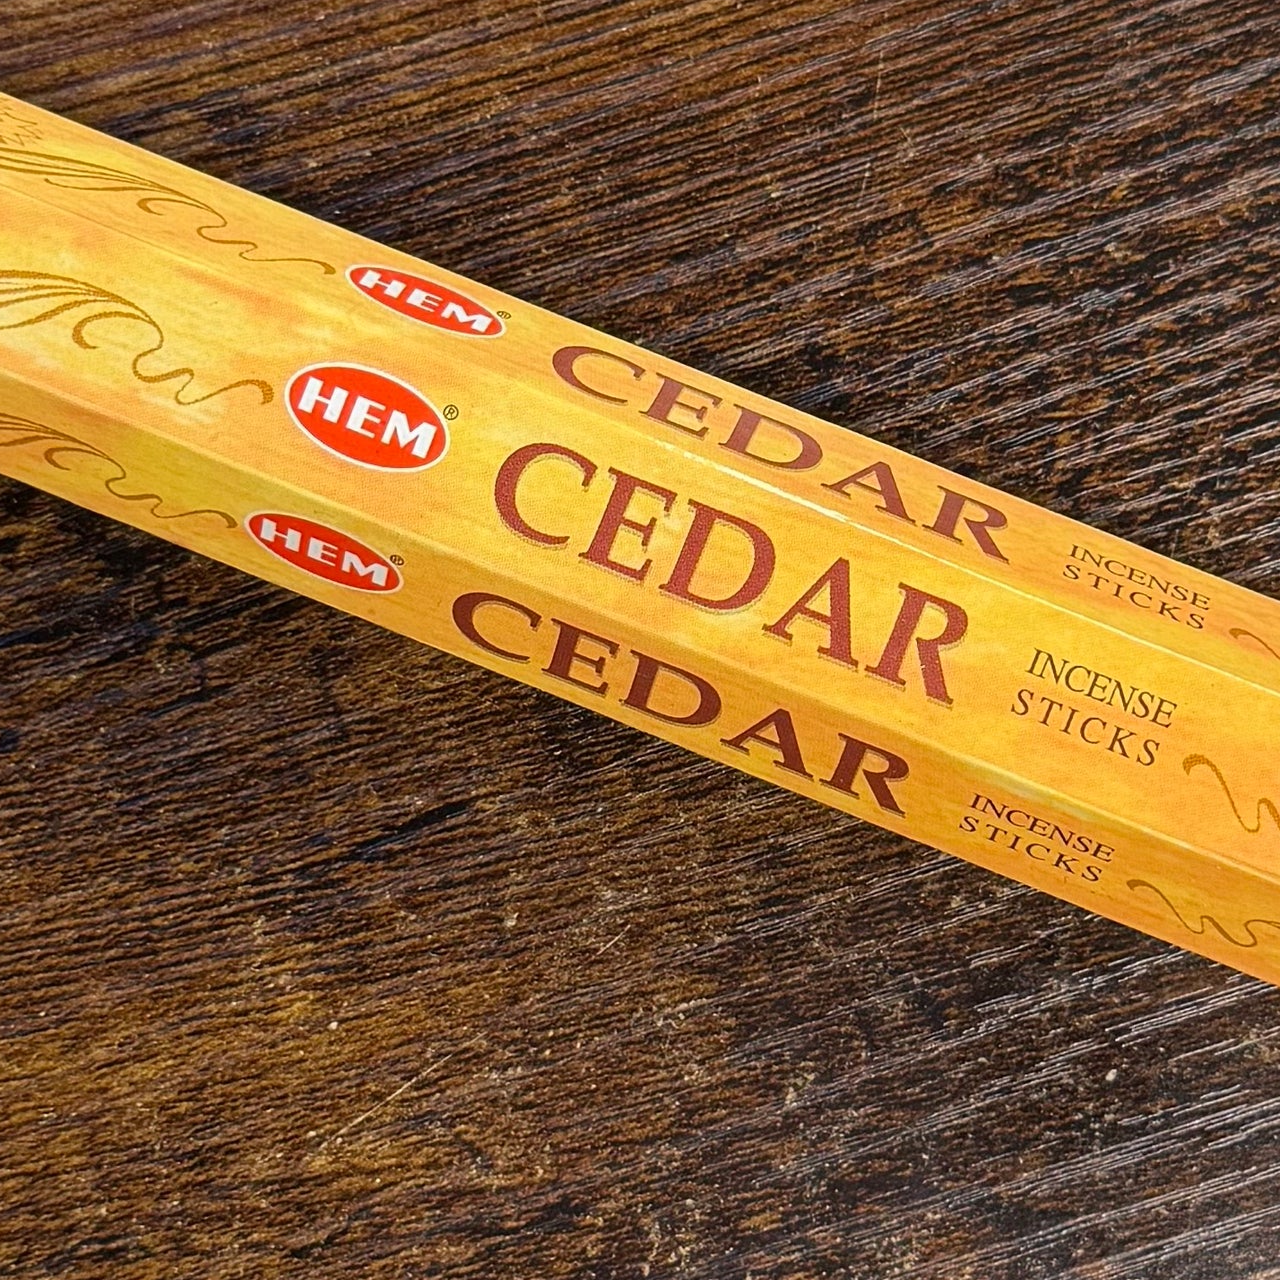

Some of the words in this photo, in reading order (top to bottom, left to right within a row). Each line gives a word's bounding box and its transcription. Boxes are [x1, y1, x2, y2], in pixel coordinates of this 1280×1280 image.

[359, 269, 493, 333] HEM
[298, 377, 437, 459] HEM
[552, 346, 1009, 564] CEDAR
[260, 518, 389, 587] HEM
[494, 443, 969, 706] CEDAR
[1069, 544, 1212, 611] INCENSE
[1062, 564, 1205, 630] STICKS
[451, 592, 911, 817] CEDAR
[1025, 647, 1178, 729] INCENSE
[1010, 688, 1161, 767] STICKS
[958, 815, 1104, 883] STICKS
[969, 792, 1116, 863] INCENSE
